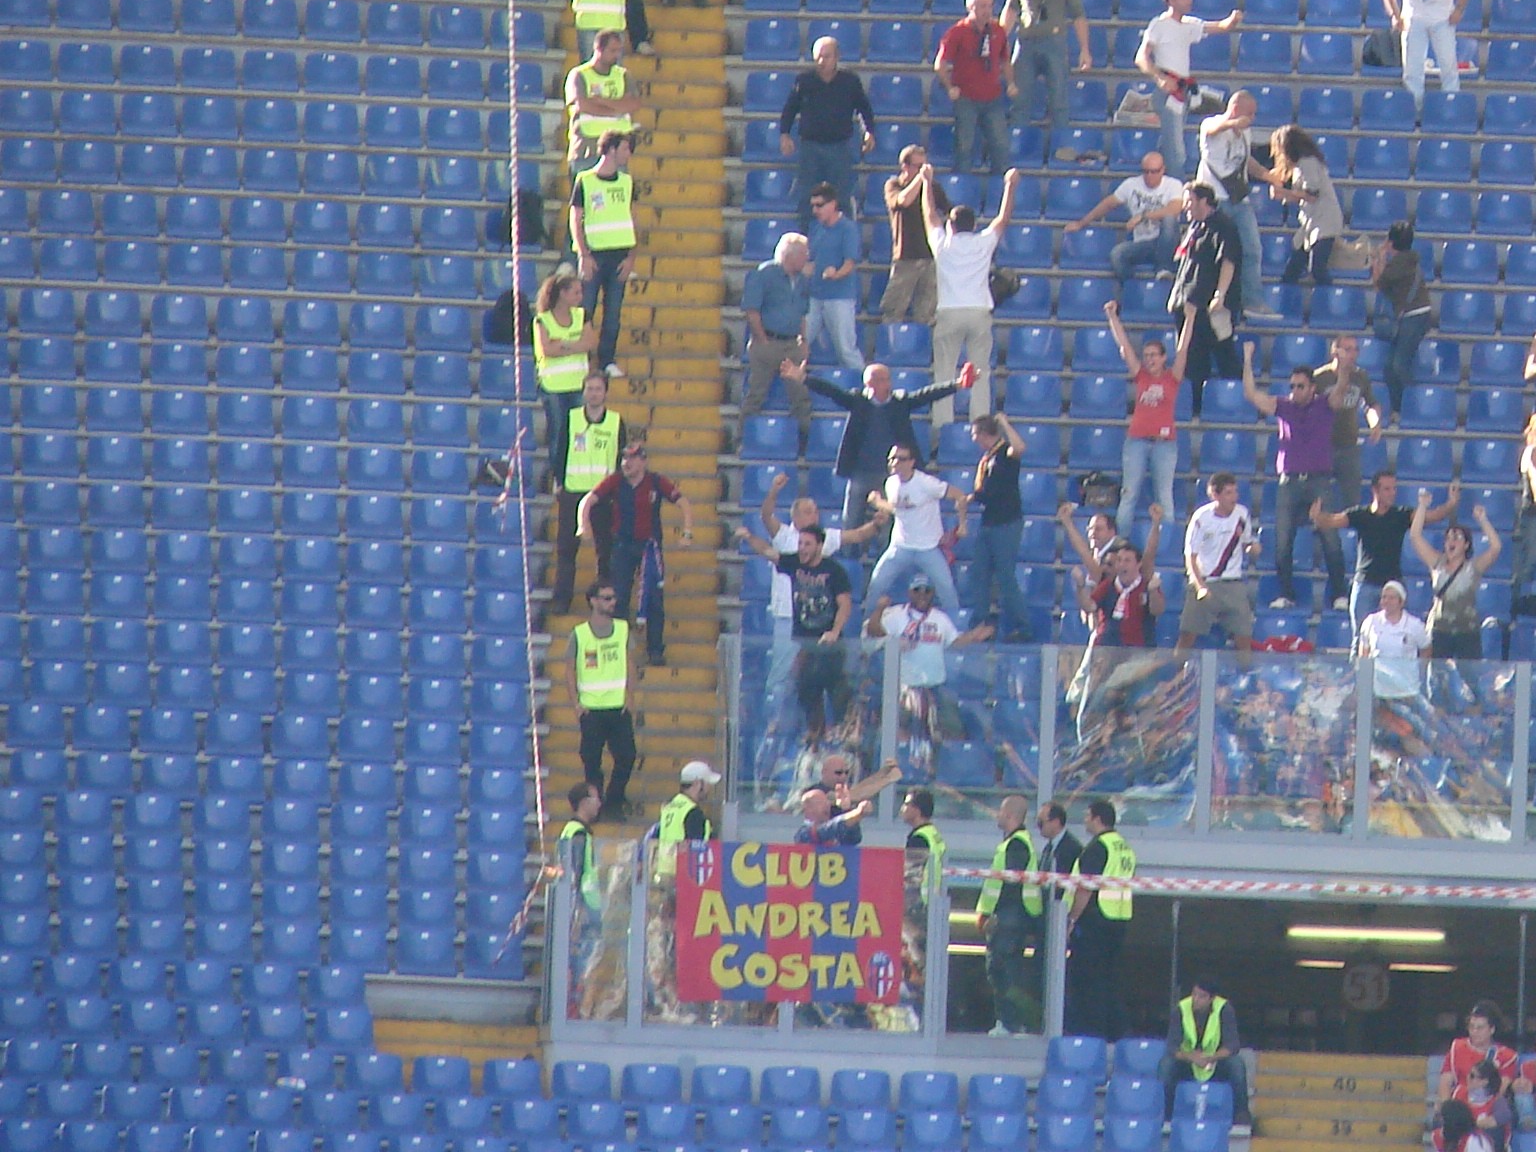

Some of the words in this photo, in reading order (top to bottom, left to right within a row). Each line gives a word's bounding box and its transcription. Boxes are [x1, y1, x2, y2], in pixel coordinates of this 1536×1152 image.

[629, 279, 648, 295] 57
[629, 329, 650, 346] 56
[731, 841, 848, 888] CLUB
[693, 889, 883, 939] ANDREA
[709, 943, 865, 990] COSTA
[1350, 973, 1383, 1001] 51
[1333, 1076, 1357, 1093] 40
[1331, 1119, 1352, 1137] 39
